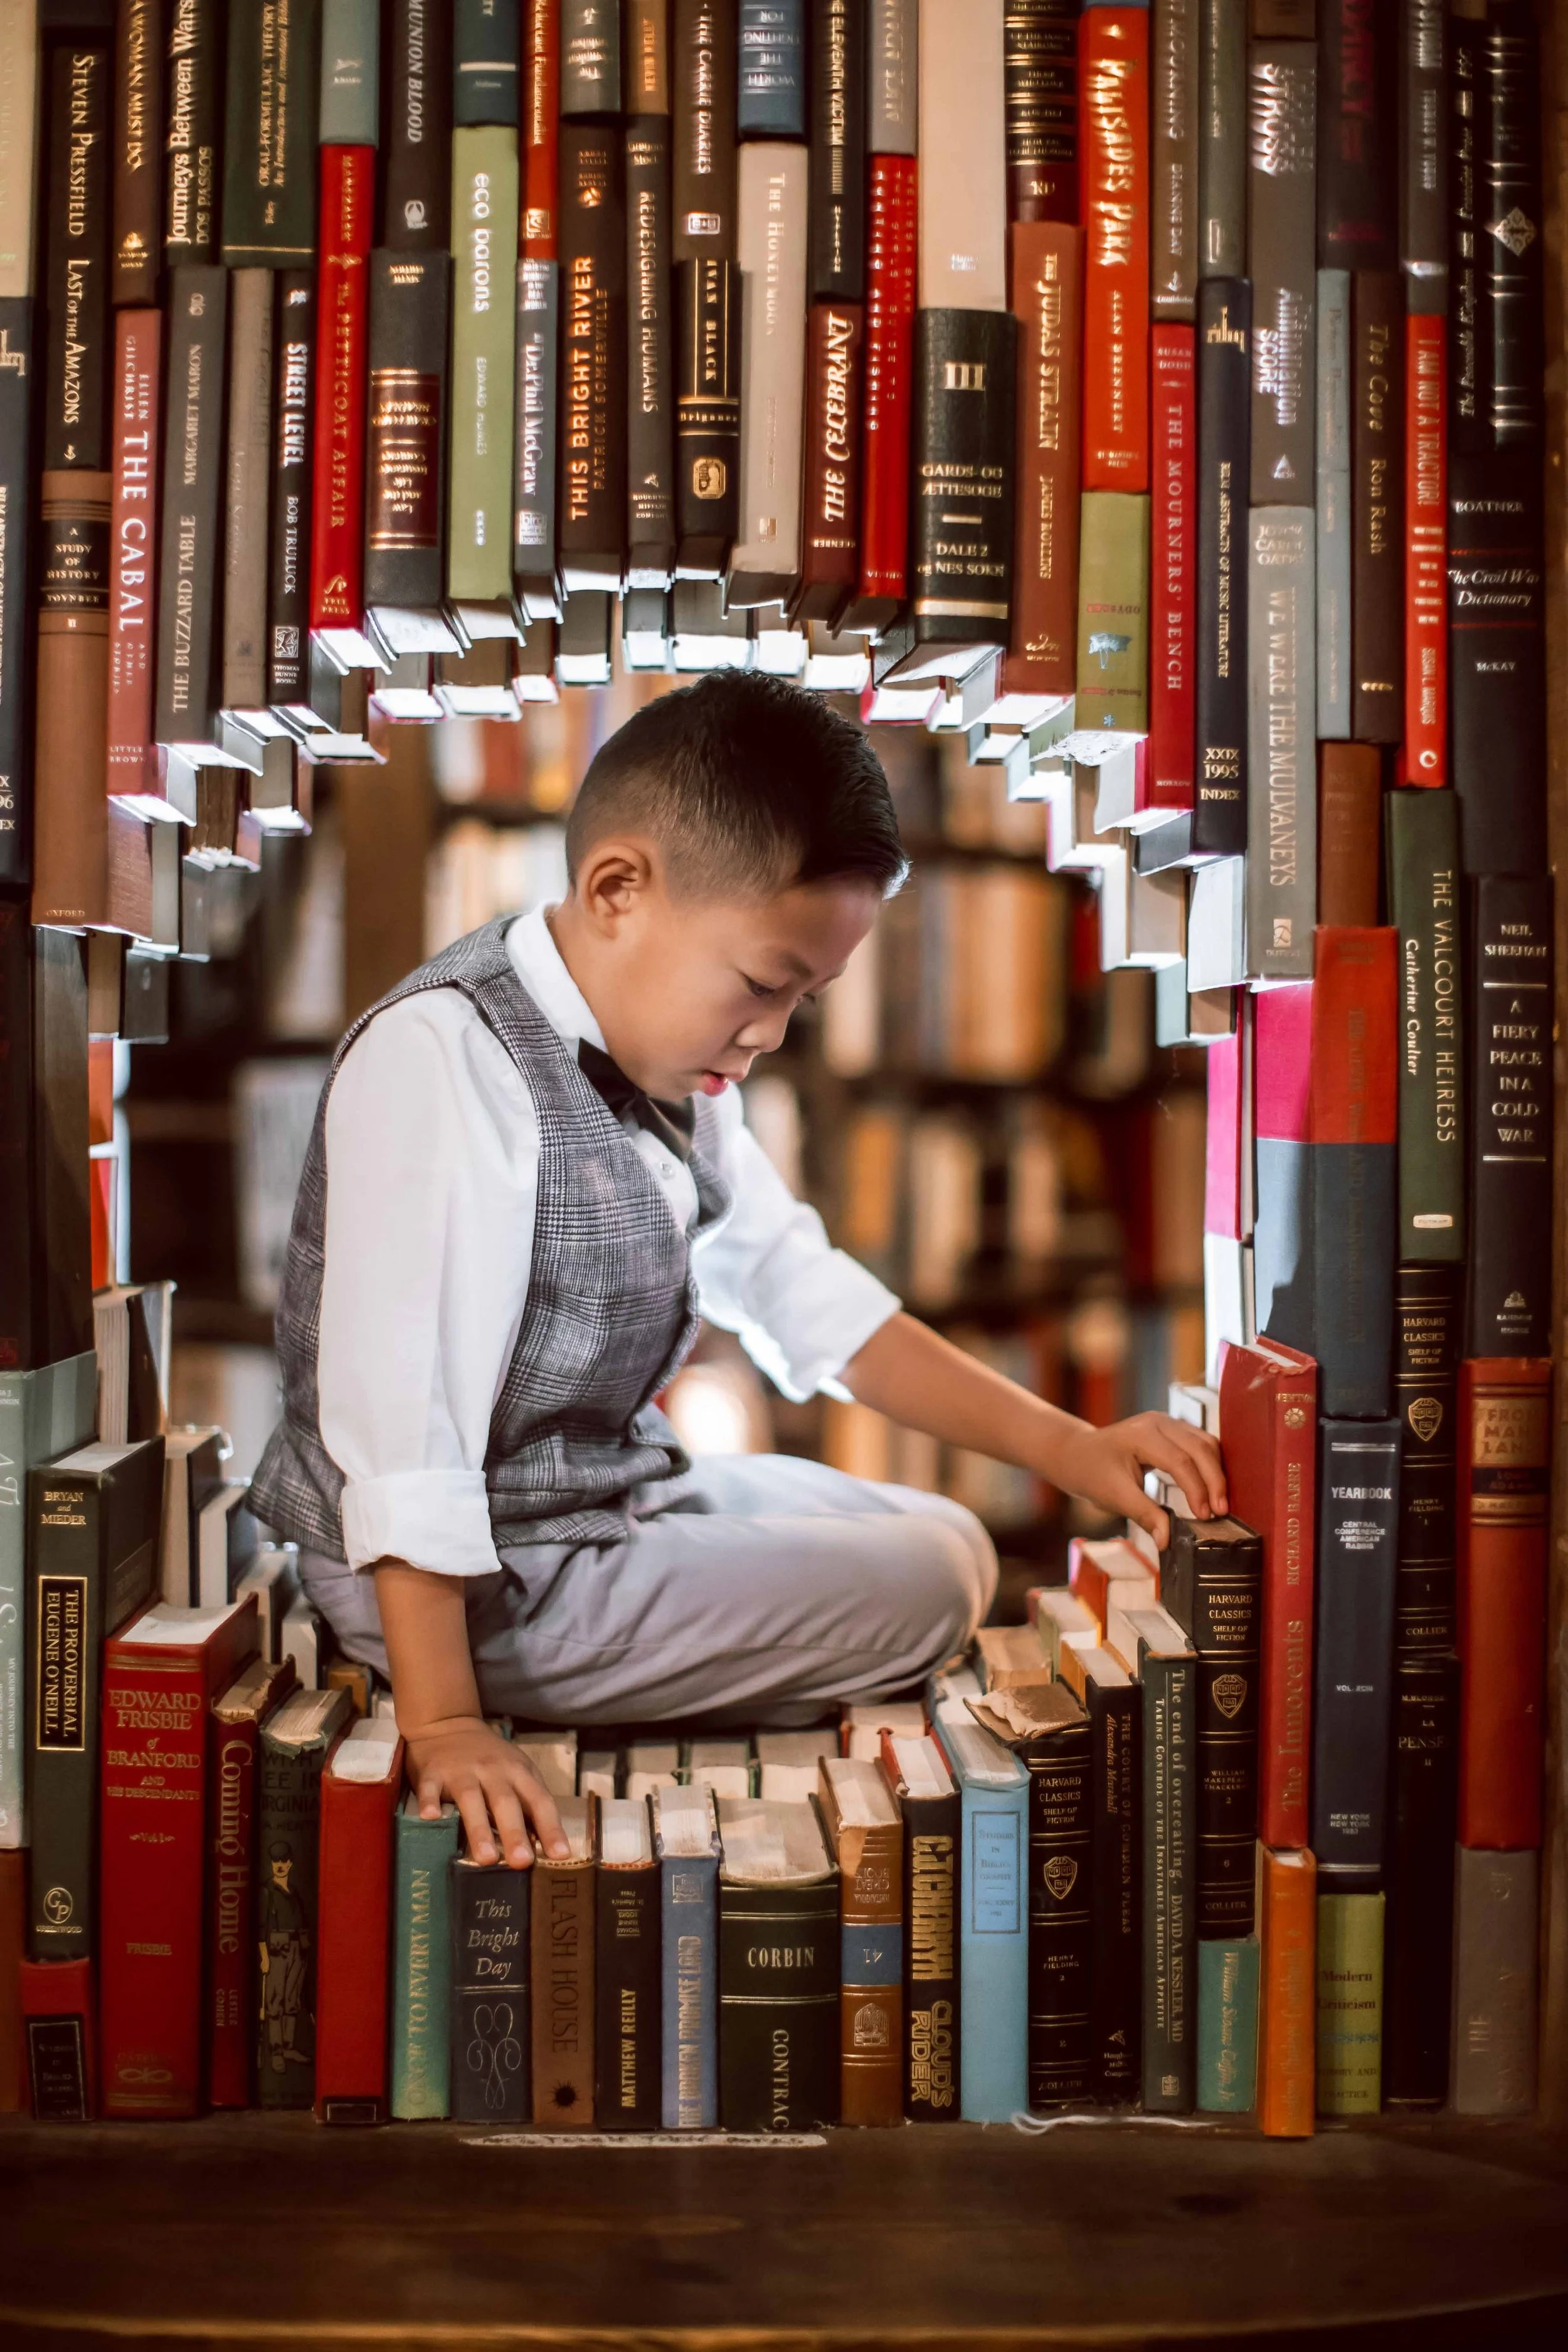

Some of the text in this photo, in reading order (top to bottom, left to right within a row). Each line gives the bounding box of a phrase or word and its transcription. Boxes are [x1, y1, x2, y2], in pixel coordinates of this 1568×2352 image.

[760, 11, 784, 23] FOR
[832, 16, 844, 88] ELEVENTH
[749, 75, 795, 85] WORTH
[832, 91, 844, 145] VICTIM
[1170, 18, 1185, 256] MOURNING DIANNE DAY
[474, 172, 490, 312] eco barons
[638, 192, 659, 413] REDESIGNING HUMANS
[705, 260, 717, 381] IVAN BLACK
[1037, 253, 1061, 450] THE JUDAS STRAIN
[1113, 290, 1123, 433] ALAN BRENNERT
[1369, 326, 1389, 431] The Cove
[571, 256, 593, 521] THIS BRIGHT RIVER
[283, 342, 308, 467] STREET LEVEL
[825, 312, 854, 522] THE CELEBRANT
[119, 431, 148, 631] THE CABAL
[55, 544, 92, 554] STUDY
[283, 496, 299, 595] BOB TRULUCK
[936, 543, 988, 557] DALE 2
[1167, 405, 1183, 690] THE MOURNERS' BENCH
[47, 570, 100, 580] HISTORY
[1456, 591, 1532, 608] Dictionary
[173, 515, 196, 713] THE BUZZARD TABLE
[1268, 588, 1296, 886] WE WERE THE MULVANEYS
[1204, 763, 1239, 778] 1995
[1200, 788, 1241, 800] INDEX
[1502, 924, 1532, 936] NEIL
[1406, 939, 1422, 1076] Catherine Coulter
[1433, 870, 1455, 1142] THE VALCOURT HEIRESS
[1510, 1000, 1521, 1013] A
[1493, 1025, 1539, 1039] FIERY
[1490, 1051, 1540, 1065] PEACE
[1491, 1104, 1539, 1116] COLD
[1498, 1128, 1534, 1142] WAR
[1404, 1317, 1445, 1327] HARVARD
[1404, 1332, 1445, 1342] CLASSICS
[1408, 1348, 1428, 1357] SHELF
[1411, 1357, 1439, 1365] FICTION
[44, 1491, 83, 1502] BRYAN
[1331, 1486, 1392, 1500] YEARBOOK
[57, 1504, 72, 1512] and
[41, 1514, 86, 1525] MIEDER
[1286, 1463, 1301, 1586] RICHARD BARRE
[1209, 1594, 1253, 1604] HARVARD
[1209, 1609, 1252, 1619] CLASSICS
[1213, 1625, 1235, 1633] SHELF
[44, 1591, 60, 1735] EUGENE O'NEILL
[63, 1590, 78, 1737] THE PROVERBIAL
[7, 1658, 15, 1750] MY JOURNEY INTO THE
[109, 1690, 201, 1710] EDWARD
[117, 1711, 193, 1730] FRISBIE
[1278, 1620, 1305, 1811] The Innocents
[147, 1738, 159, 1751] of
[107, 1750, 201, 1769] BRANFORD
[1106, 1714, 1117, 1815] Alexandra Marshall
[140, 1776, 165, 1786] AND
[1039, 1776, 1081, 1787] HARVARD
[1039, 1791, 1081, 1802] CLASSICS
[216, 1740, 252, 1954] Coming Home
[1168, 1670, 1185, 2041] The end of overeating. DAVID A. KESSLER, MD
[475, 1899, 512, 1919] This
[1205, 1901, 1247, 1910] COLLIER
[36, 1925, 82, 1934] GREENWOOD
[468, 1929, 519, 1953] Bright
[551, 1879, 578, 2053] FLASH HOUSE
[748, 1947, 815, 1968] CORBIN
[1044, 1961, 1079, 1969] FIELDING
[1048, 1954, 1074, 1963] HENRY
[475, 1957, 512, 1981] Day
[1322, 1971, 1373, 1982] Modern
[216, 1989, 225, 2026] COHEN
[621, 1989, 635, 2108] MATTHEW REILLY
[911, 2000, 953, 2109] CLOUD'S RIDER
